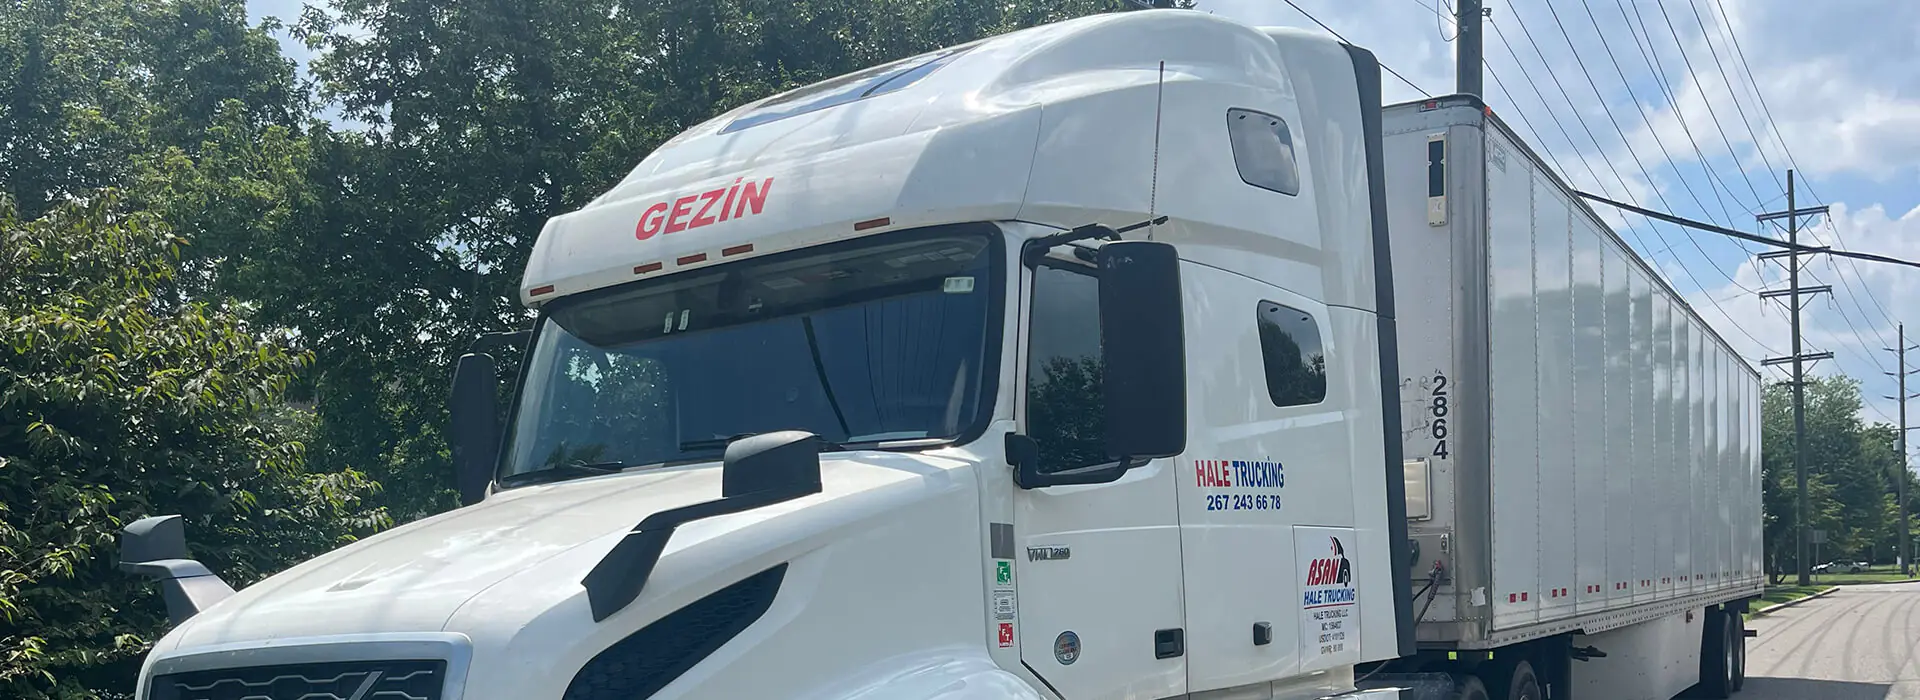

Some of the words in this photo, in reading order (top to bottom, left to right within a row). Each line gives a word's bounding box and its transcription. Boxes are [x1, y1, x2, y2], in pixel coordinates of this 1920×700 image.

[1432, 376, 1448, 459] 2864
[1195, 460, 1231, 487] HALE
[1207, 495, 1229, 510] 267
[1234, 495, 1253, 510] 243
[1256, 495, 1268, 510] 66
[1270, 495, 1281, 510] 78
[1307, 559, 1339, 586] ASAN
[1304, 590, 1322, 605] HALE
[1324, 588, 1355, 603] TRUCKING
